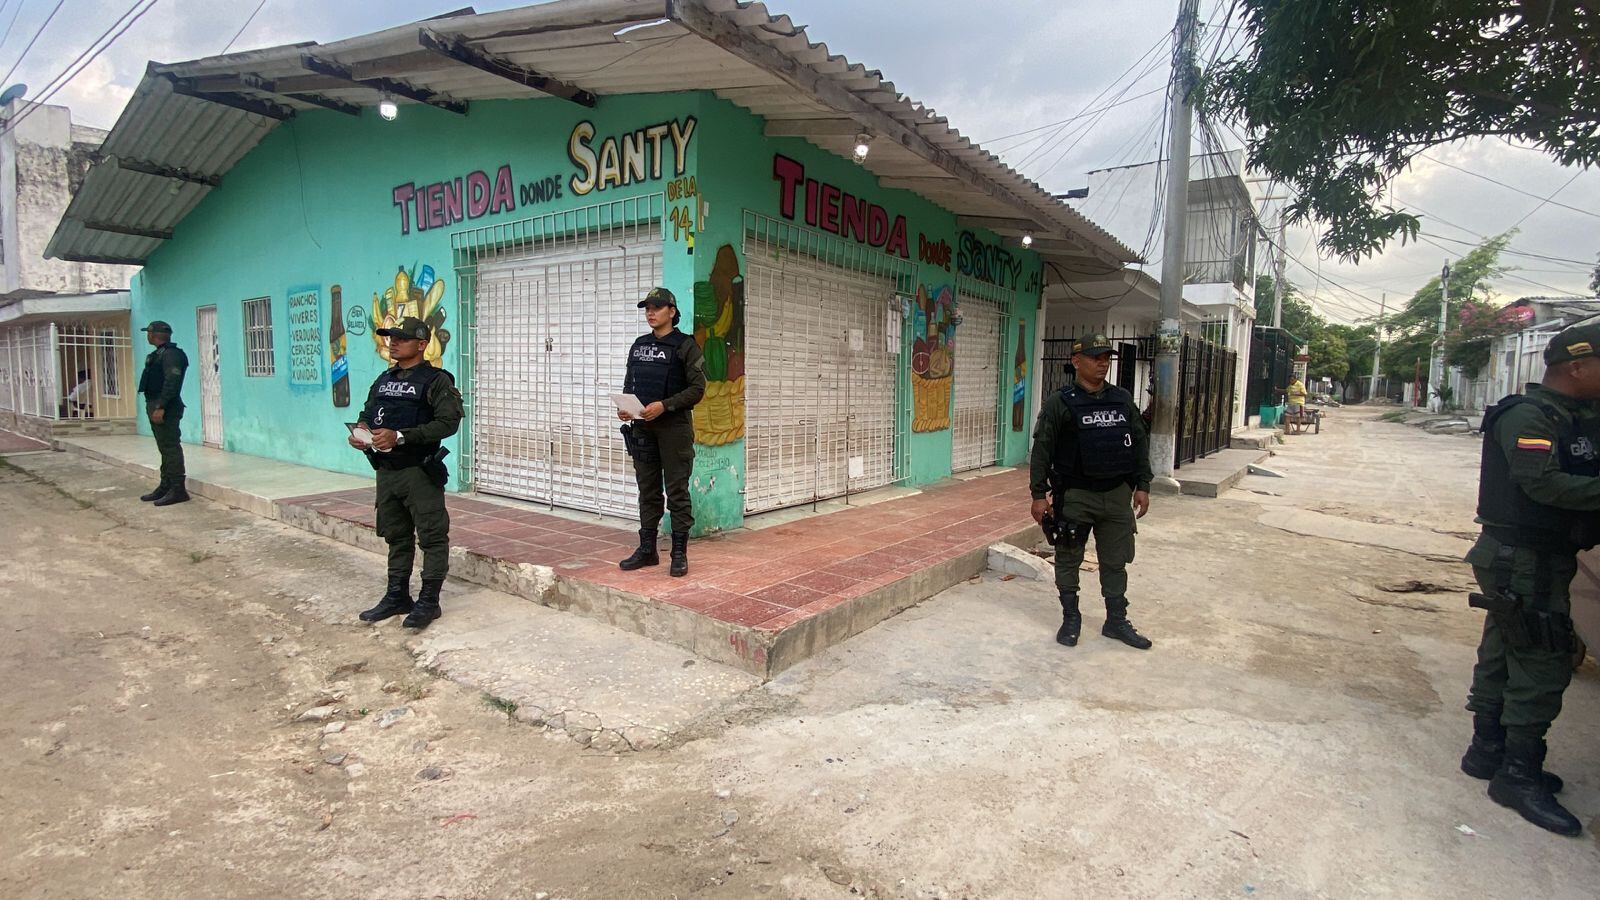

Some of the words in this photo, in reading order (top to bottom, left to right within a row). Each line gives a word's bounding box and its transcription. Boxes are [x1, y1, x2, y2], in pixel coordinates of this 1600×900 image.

[393, 164, 516, 235] TIENDA
[520, 174, 563, 207] DONDE
[568, 115, 697, 196] SANTY
[667, 180, 682, 202] DE
[683, 175, 696, 198] LA
[773, 153, 910, 258] TIENDA
[670, 205, 694, 242] 14
[633, 350, 666, 359] GAULA
[378, 383, 416, 395] GAULA
[1082, 414, 1126, 424] GAULA
